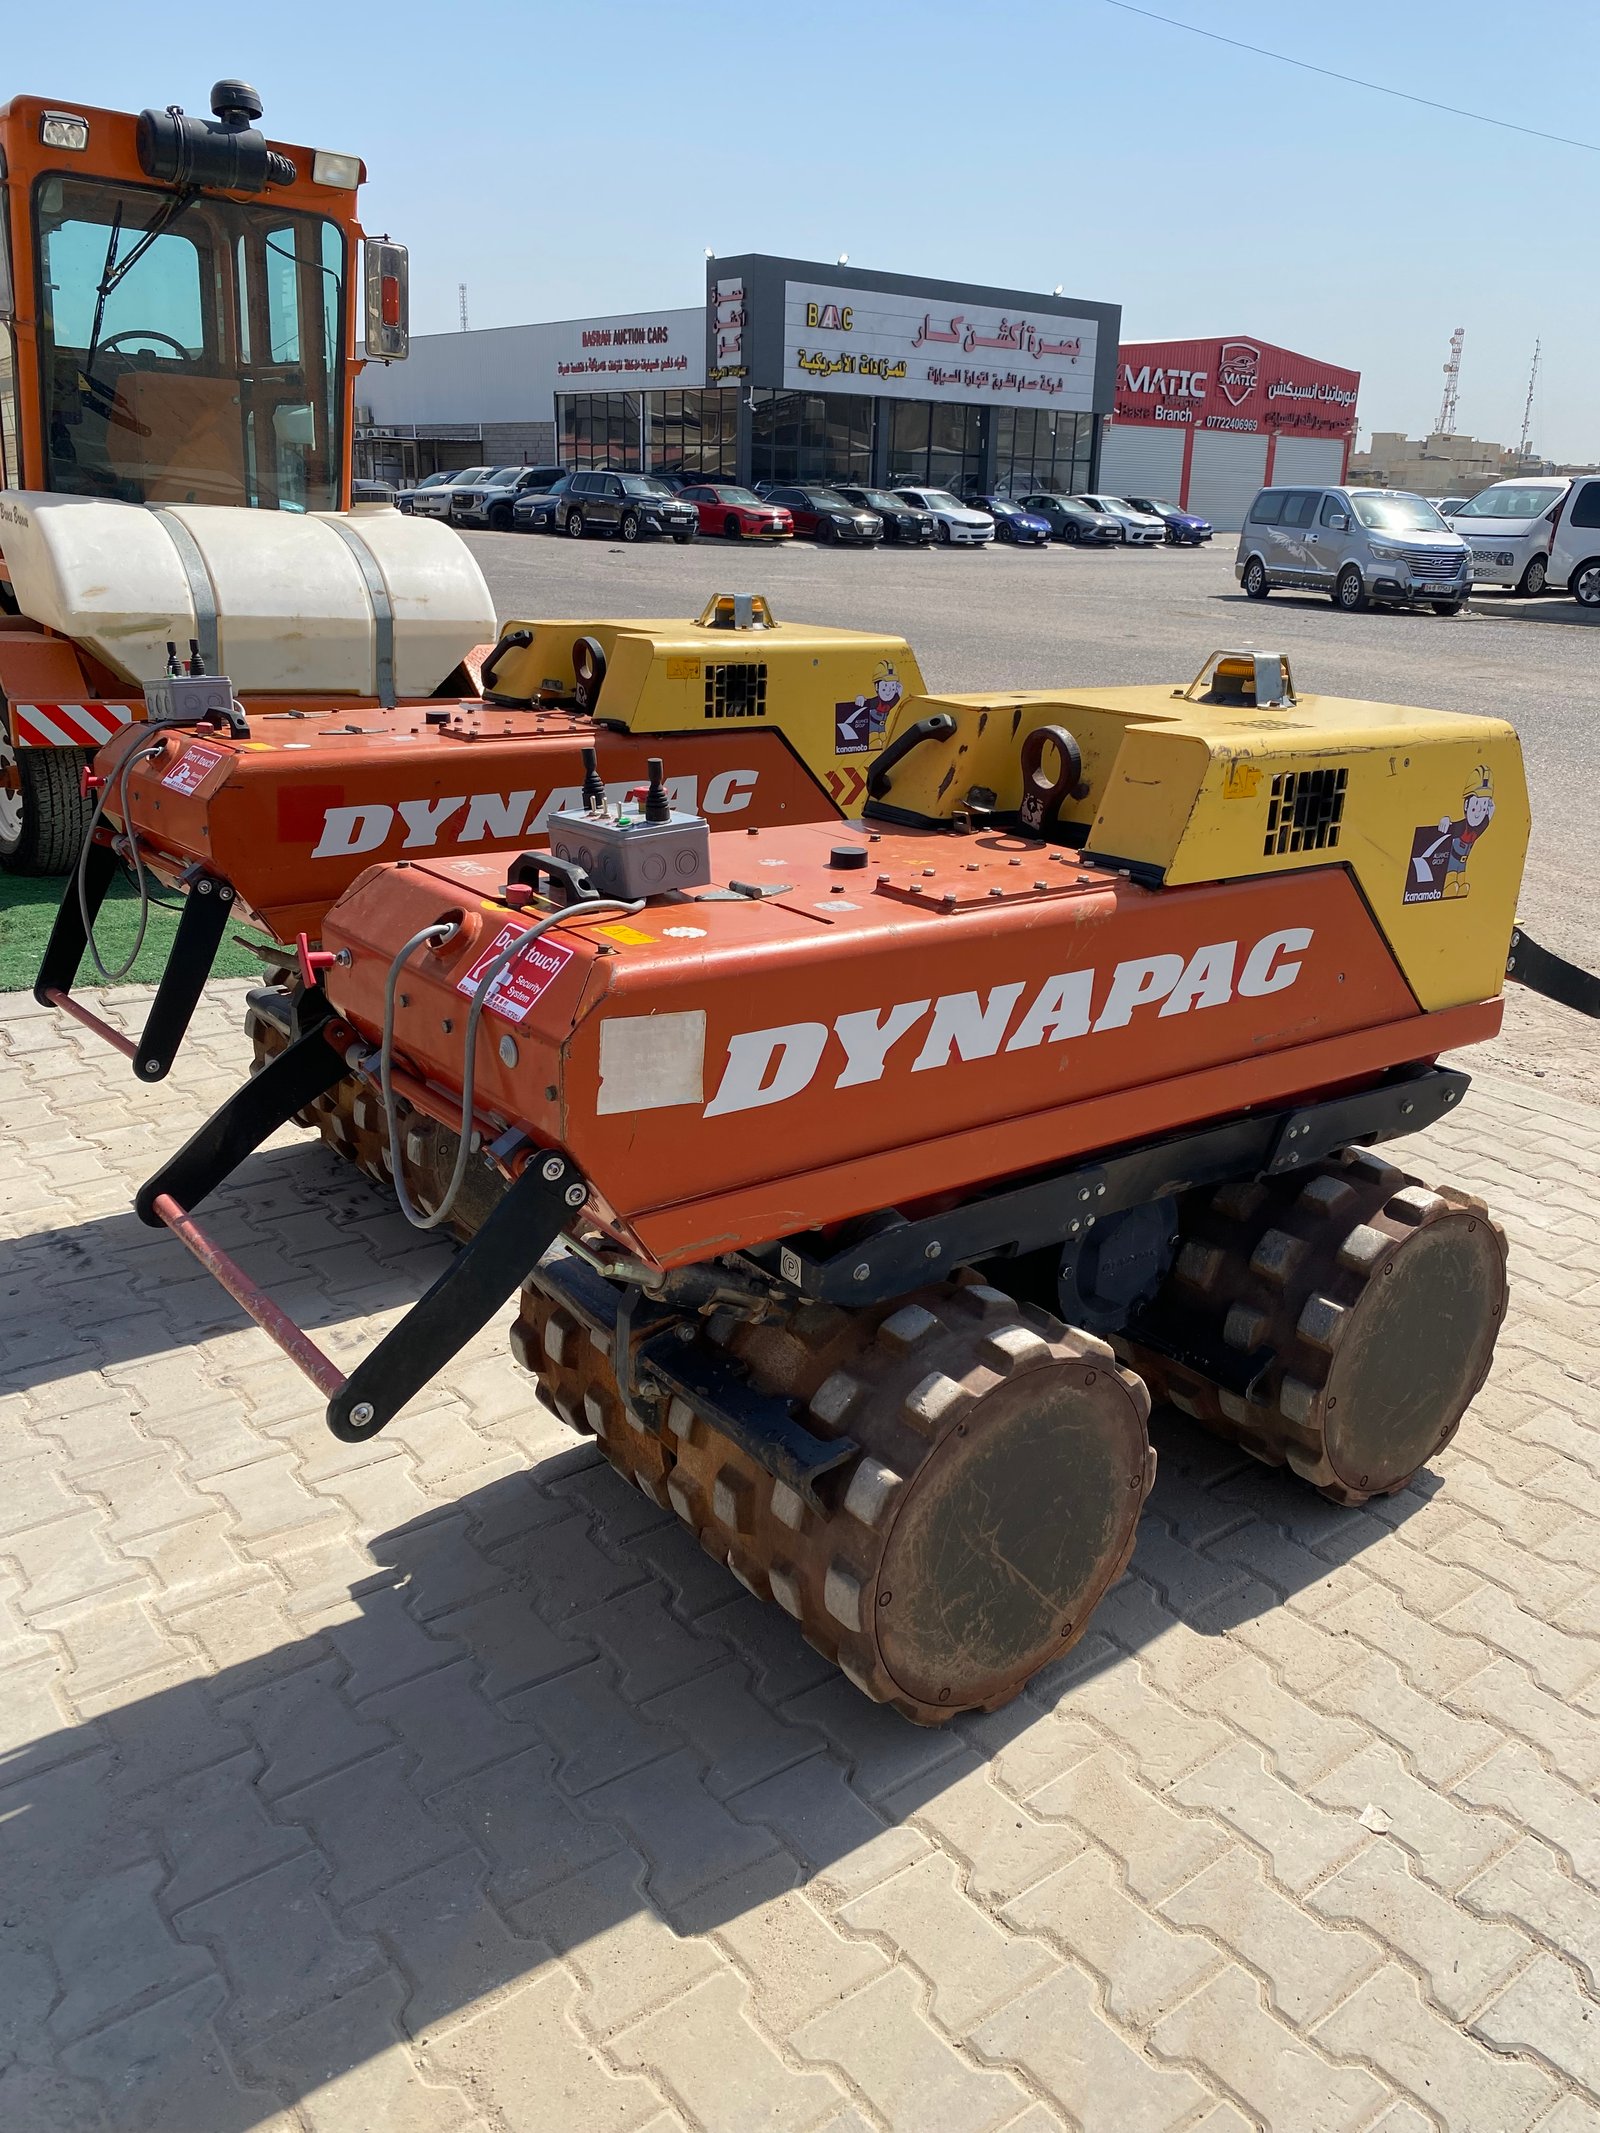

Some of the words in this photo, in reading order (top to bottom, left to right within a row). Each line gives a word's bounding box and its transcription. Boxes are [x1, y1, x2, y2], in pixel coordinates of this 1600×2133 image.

[806, 303, 853, 331] BAC
[612, 328, 645, 346] AUCTION
[647, 326, 668, 344] CARS
[911, 313, 964, 348] كار
[963, 317, 1026, 352] أكشن
[1026, 325, 1081, 364] بصرة
[798, 349, 856, 377] الأمريكية
[859, 355, 908, 381] للمزادات
[1154, 405, 1193, 422] Branch
[1207, 415, 1258, 431] 07722406969
[836, 744, 868, 753] kanamoto
[197, 756, 215, 769] touch
[1404, 889, 1441, 902] kanamoto
[495, 931, 529, 958] Dot
[524, 946, 561, 974] touch
[507, 986, 531, 1003] System
[515, 975, 542, 995] Security
[703, 928, 1314, 1118] DYNAPAC
